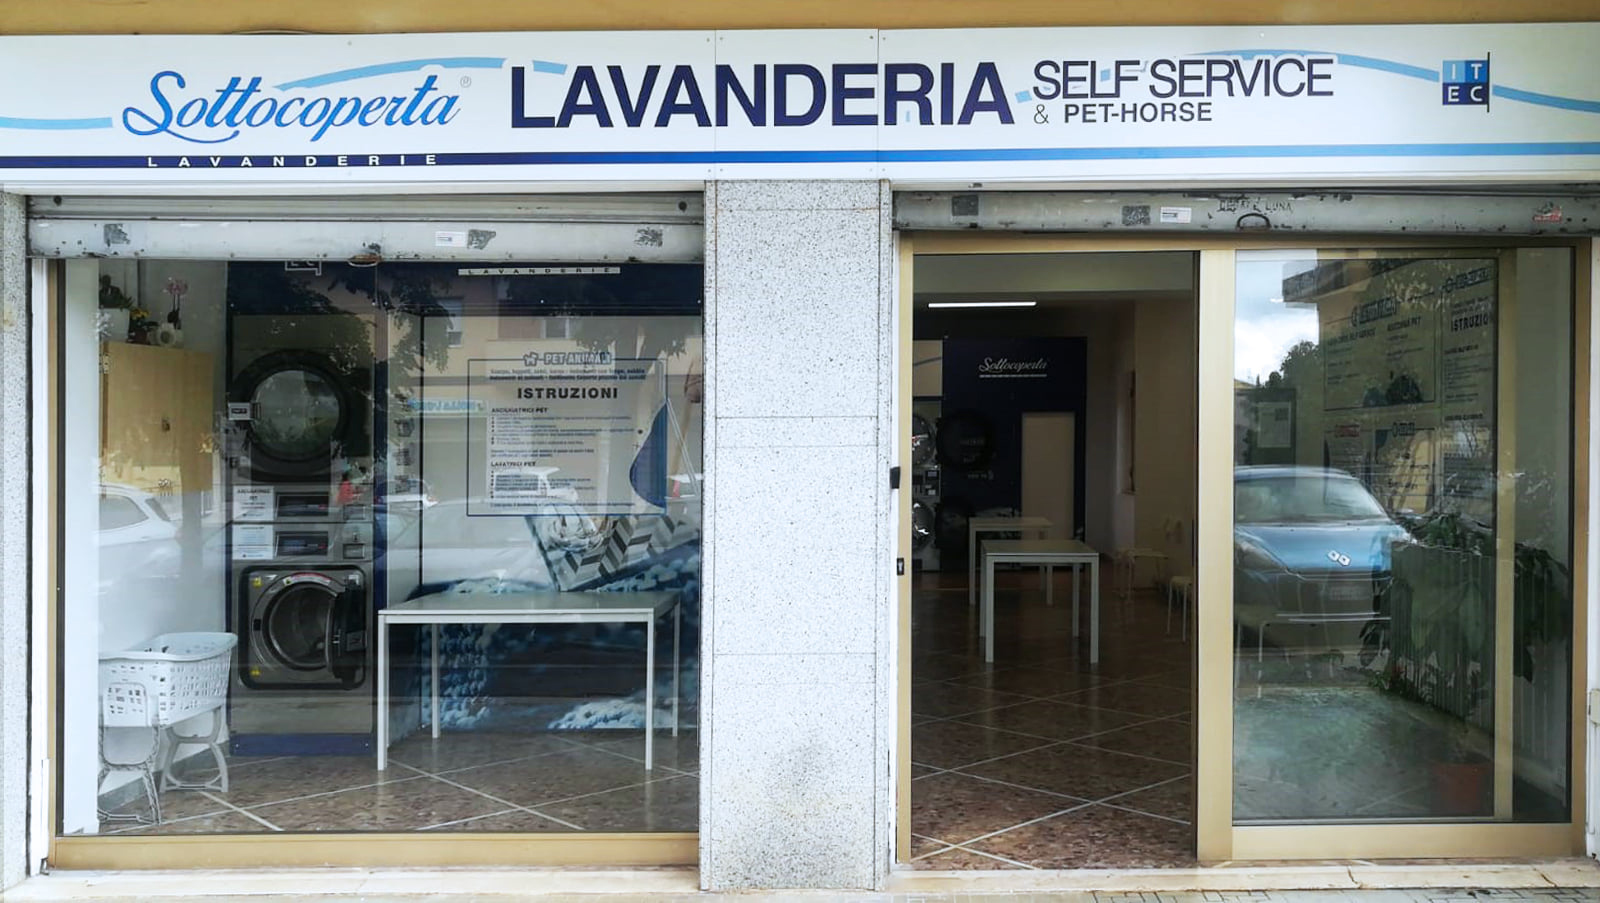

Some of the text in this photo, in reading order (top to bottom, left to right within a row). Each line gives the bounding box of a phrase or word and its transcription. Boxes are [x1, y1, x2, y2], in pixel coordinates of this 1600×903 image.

[1033, 58, 1334, 100] SELF SERVICE
[511, 62, 1015, 128] LAVANDERIA
[122, 70, 461, 144] Sottocoperta
[1033, 102, 1213, 124] & PET-HORSE
[148, 154, 437, 167] LAVANDERIE
[467, 267, 611, 275] LAVANDERIE
[543, 352, 566, 365] PET
[517, 387, 618, 399] ISTRUZIONI
